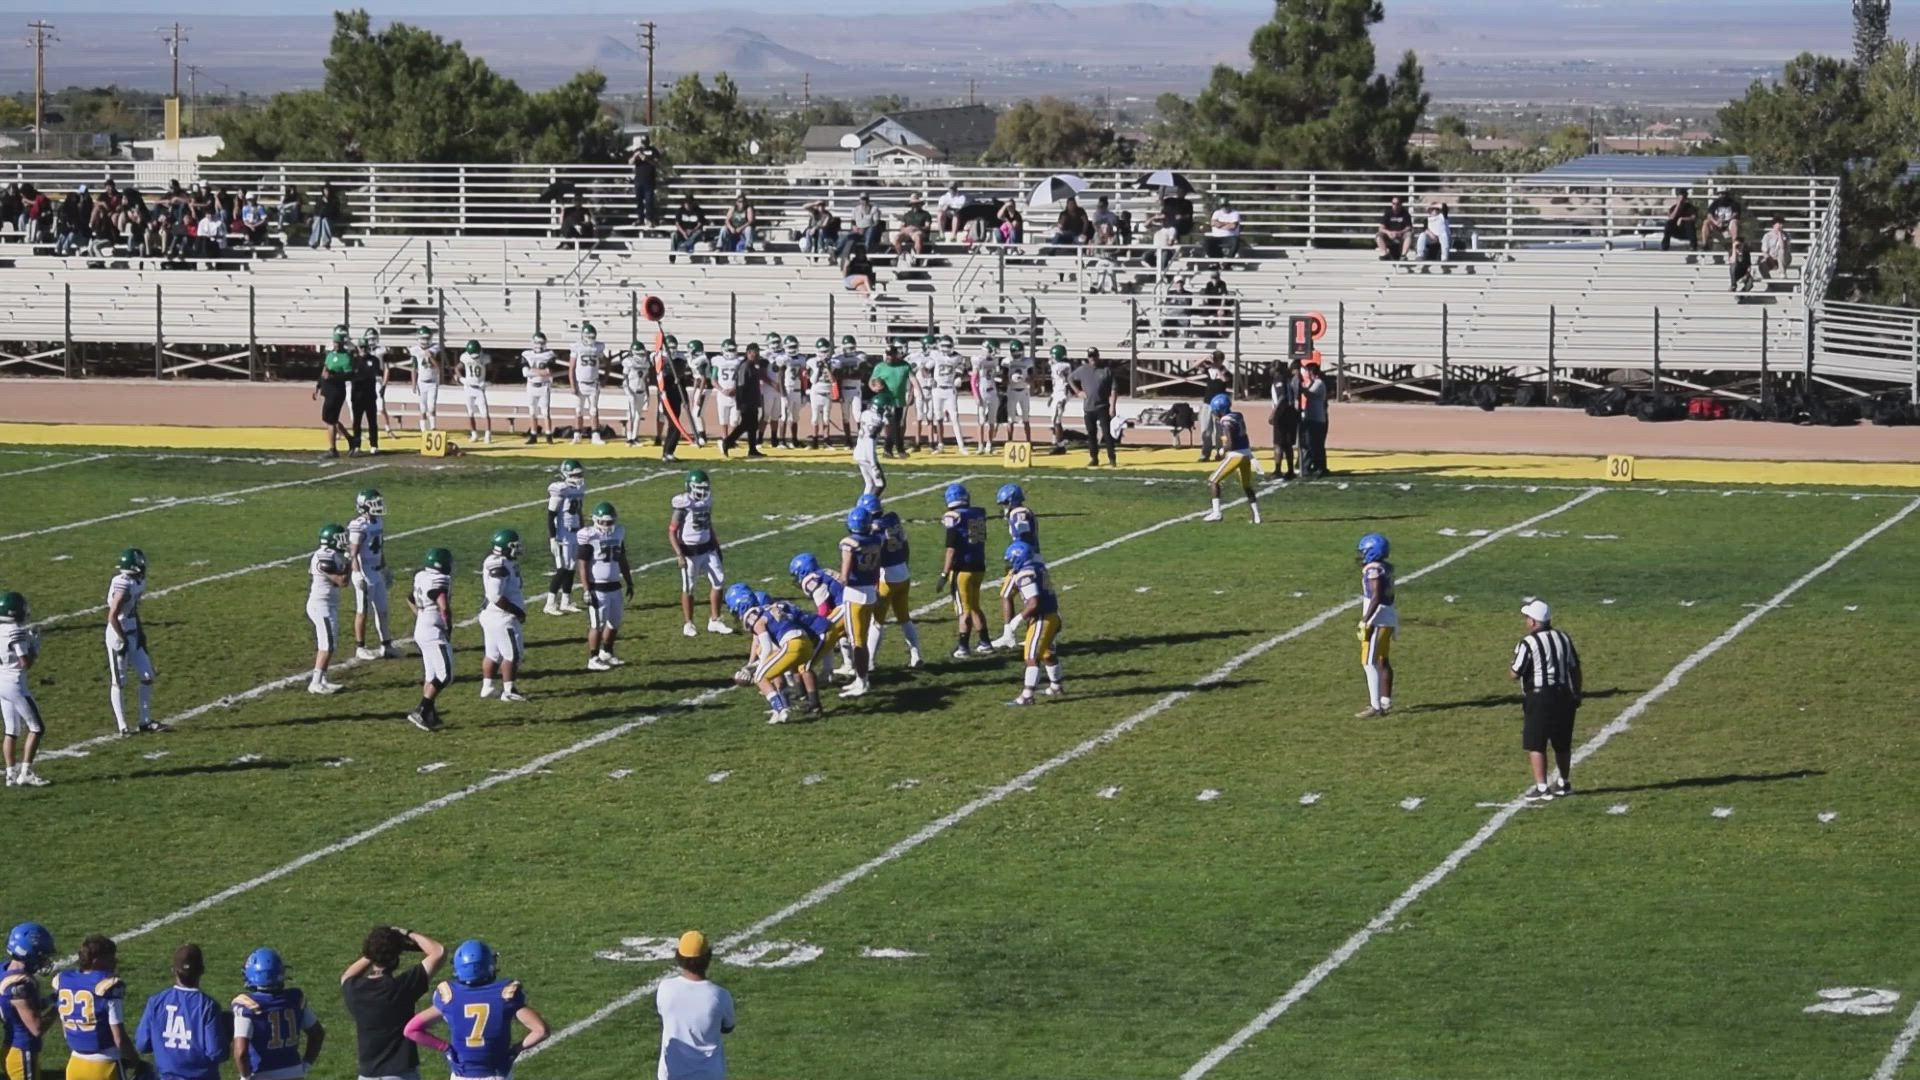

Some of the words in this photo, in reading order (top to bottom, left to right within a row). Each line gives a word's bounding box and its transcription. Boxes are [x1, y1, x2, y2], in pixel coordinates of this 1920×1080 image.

[581, 354, 597, 367] 55
[426, 433, 442, 451] 50
[1009, 444, 1026, 463] 40
[1611, 458, 1629, 477] 30
[58, 988, 96, 1032] 23
[464, 1002, 490, 1047] 7
[162, 1004, 192, 1050] LA
[267, 1007, 299, 1049] 11
